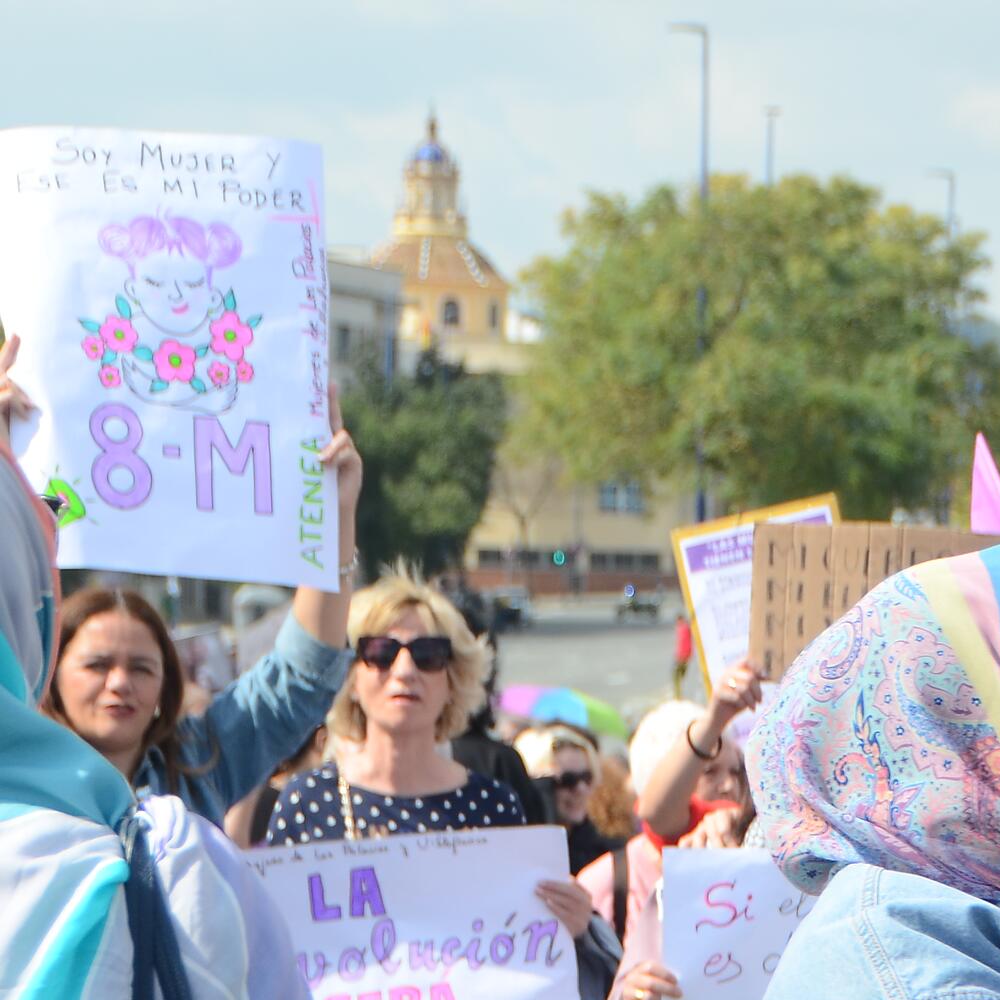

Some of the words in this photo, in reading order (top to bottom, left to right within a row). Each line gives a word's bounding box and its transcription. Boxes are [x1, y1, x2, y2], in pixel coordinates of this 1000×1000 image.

[103, 169, 137, 193] ES
[164, 179, 198, 199] MI
[221, 180, 306, 212] PODER
[299, 434, 325, 570] ATENEA
[307, 866, 386, 922] LA
[695, 879, 755, 933] Si
[296, 912, 563, 986] volución
